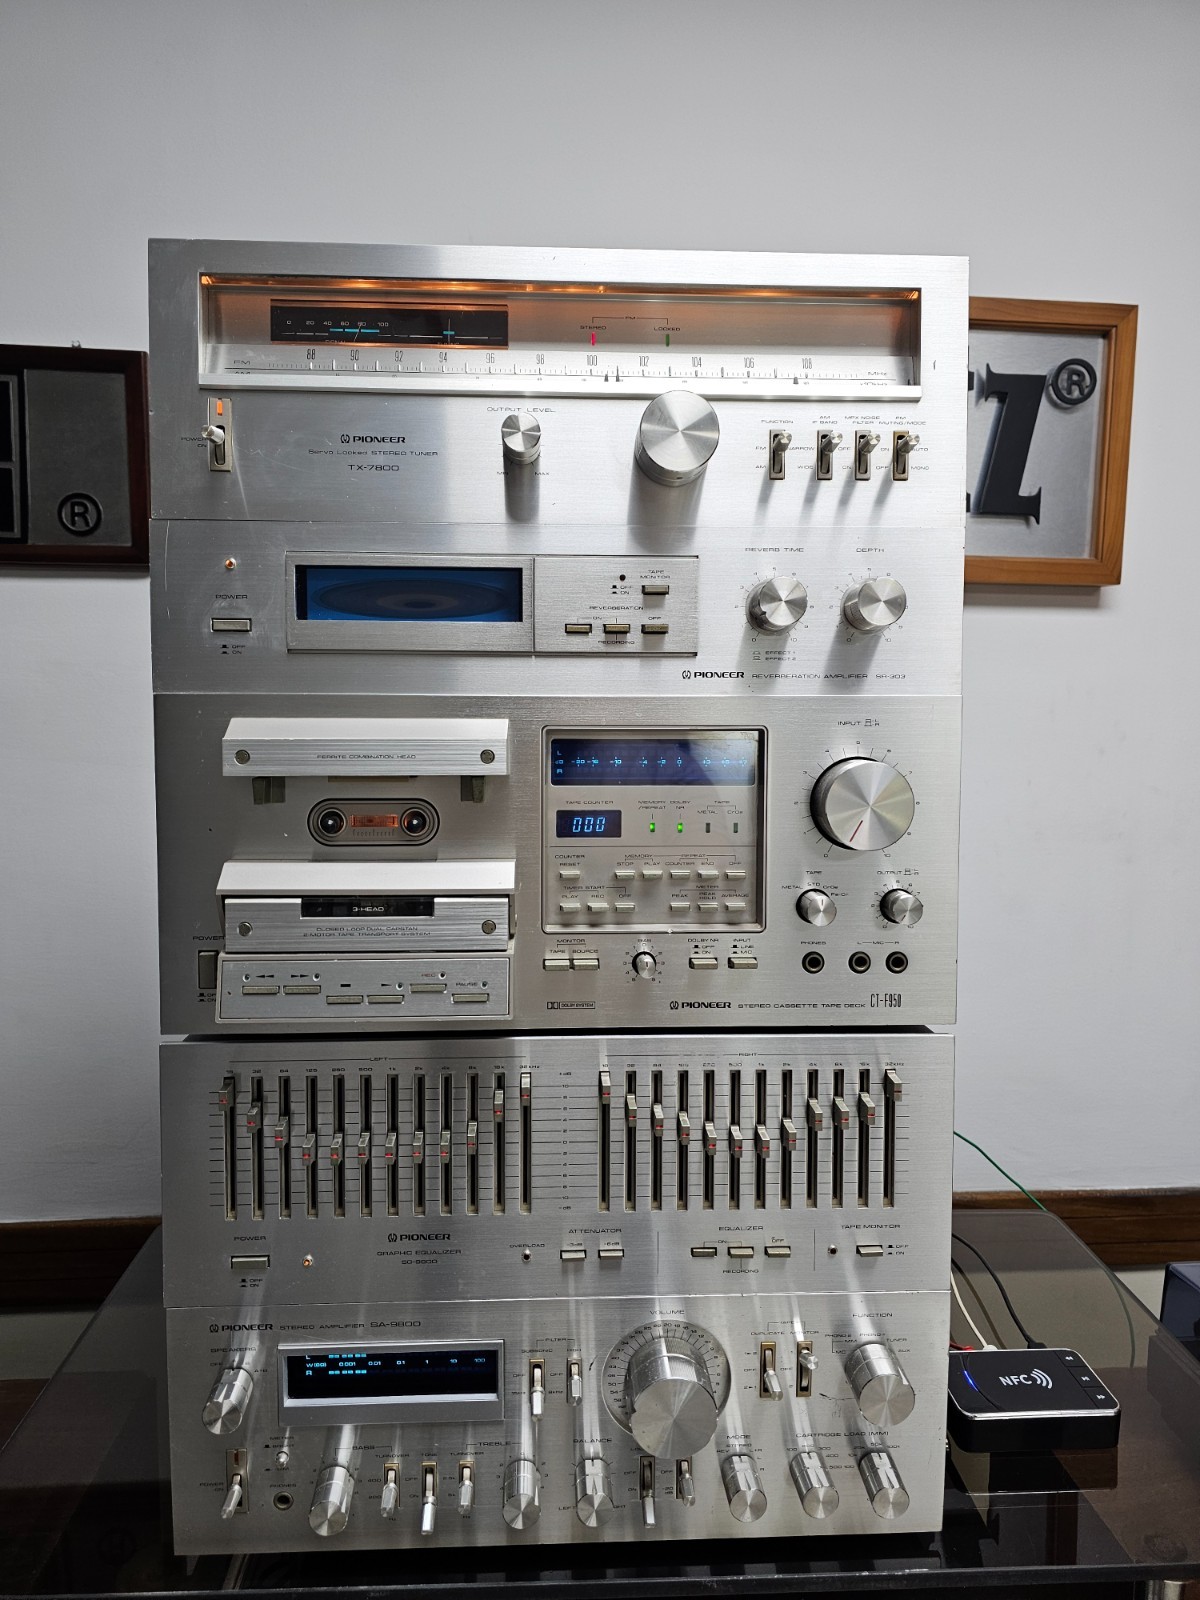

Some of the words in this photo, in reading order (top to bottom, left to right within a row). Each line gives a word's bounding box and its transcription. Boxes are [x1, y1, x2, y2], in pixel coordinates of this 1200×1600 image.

[306, 349, 316, 360] 88
[350, 350, 360, 360] 90
[394, 350, 403, 362] 92
[439, 352, 448, 363] 94
[486, 352, 494, 364] 96
[536, 354, 544, 365] 98
[586, 354, 598, 366] 100
[638, 356, 650, 366] 102
[692, 356, 702, 368] 104
[744, 357, 754, 368] 106
[802, 358, 812, 369] 108
[352, 435, 406, 444] PIONEER
[348, 464, 400, 472] TX-7800
[694, 671, 745, 679] PIONEER
[572, 817, 605, 832] 000
[870, 994, 902, 1008] CT-F950
[400, 1233, 451, 1242] PIONEER
[221, 1323, 274, 1332] PIONEER
[999, 1374, 1032, 1386] NFC
